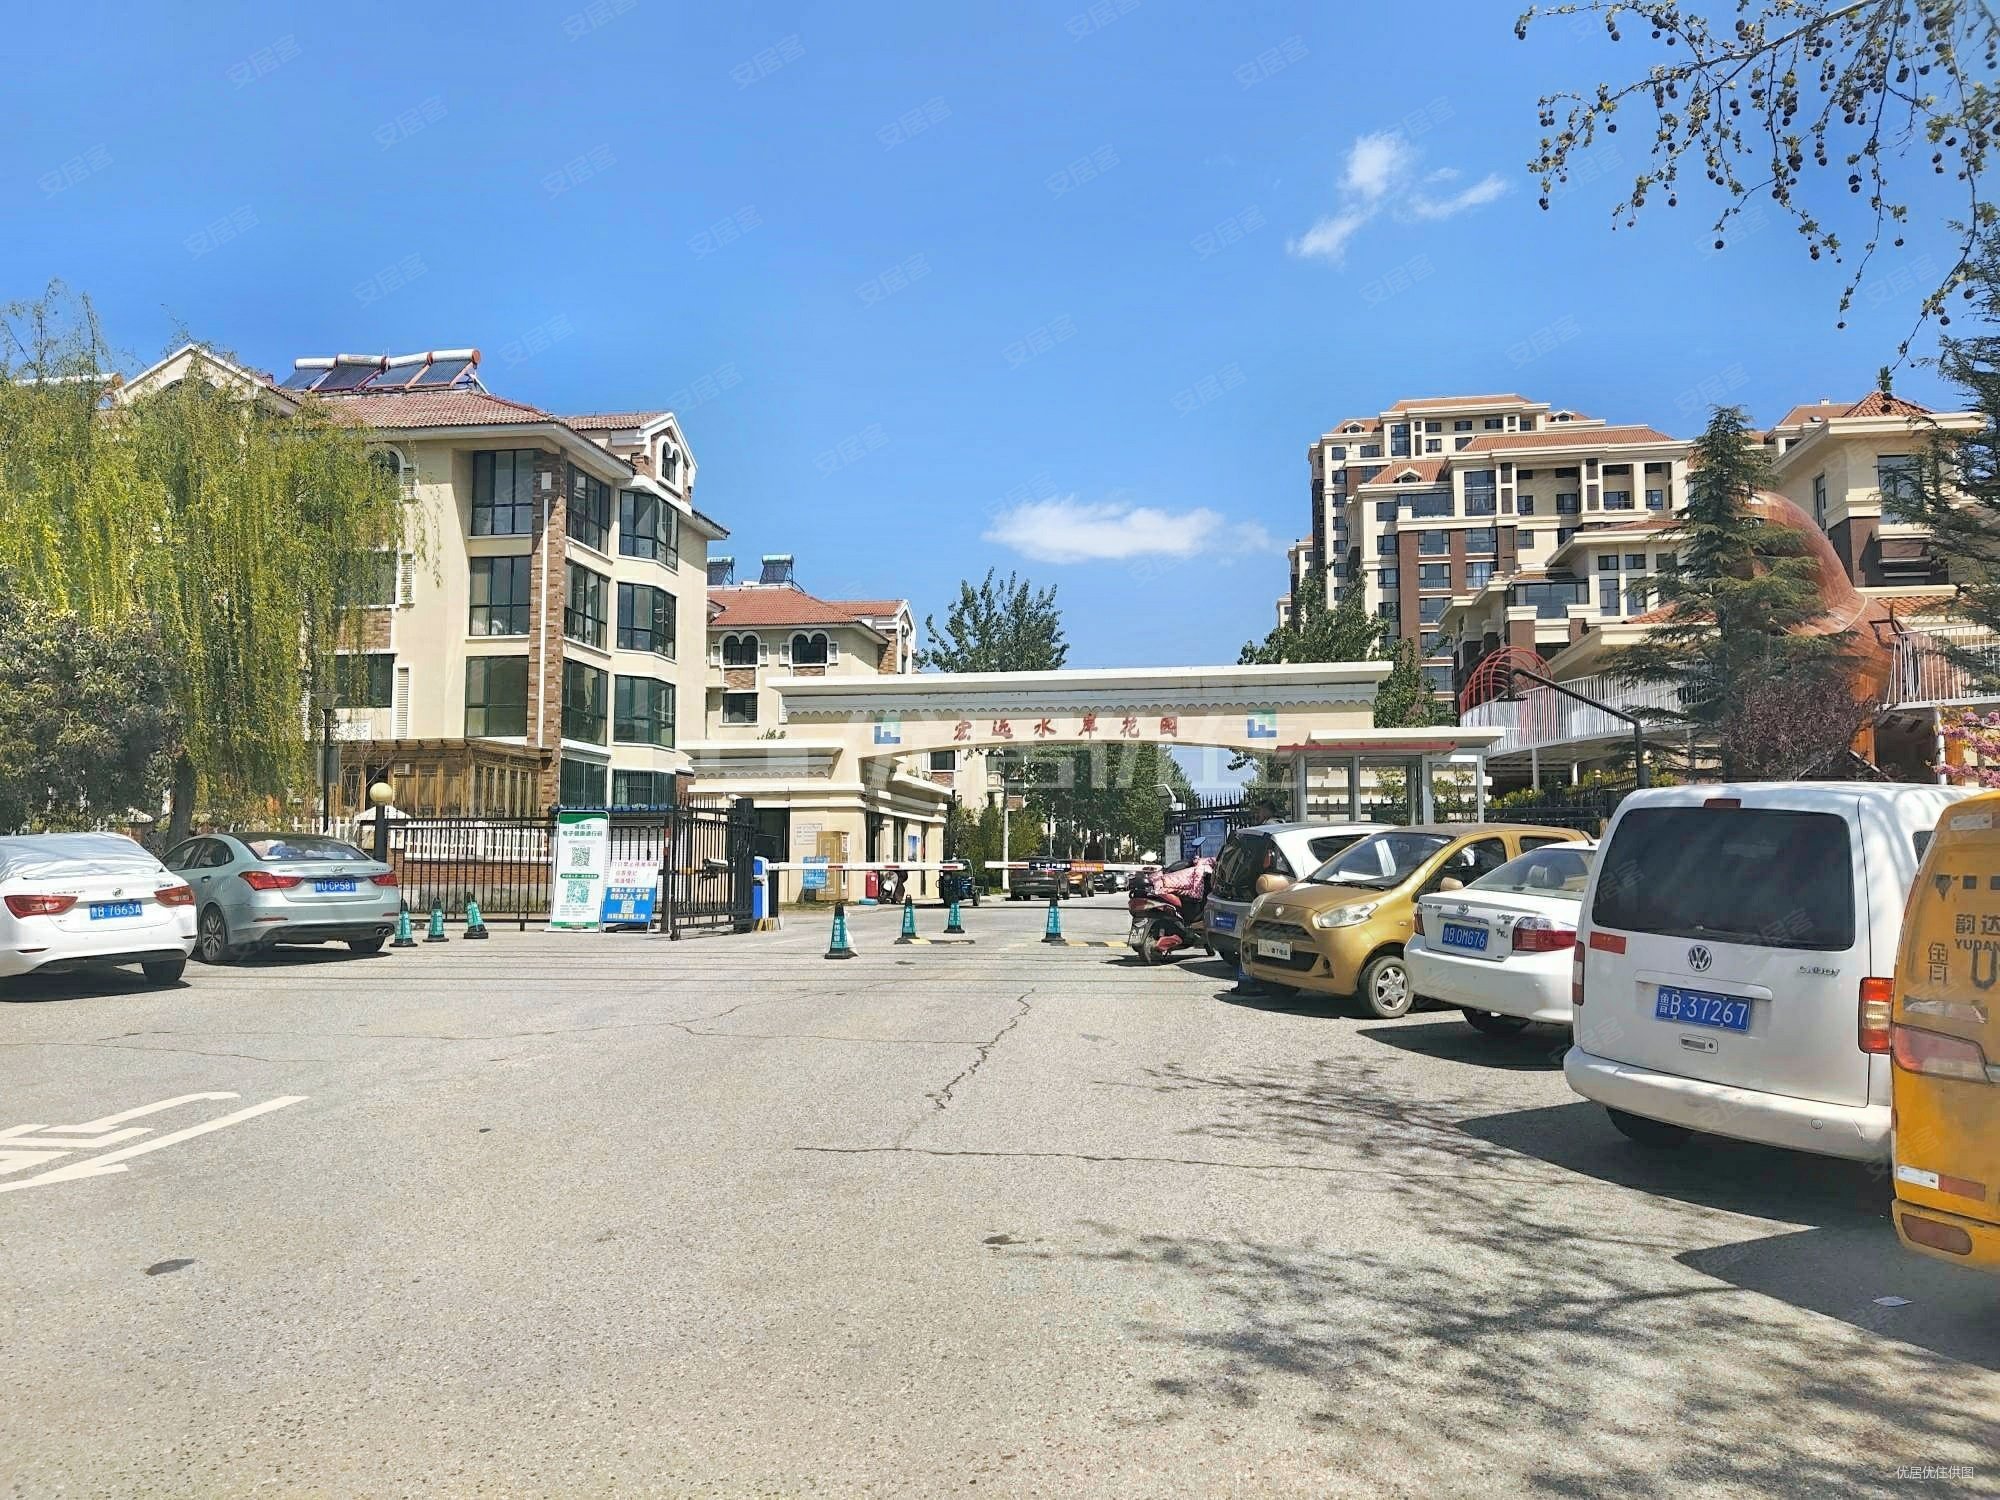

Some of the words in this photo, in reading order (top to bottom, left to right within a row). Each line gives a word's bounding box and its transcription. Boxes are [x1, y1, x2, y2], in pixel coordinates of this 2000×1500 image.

[953, 712, 1179, 742] 宏远水岸花园
